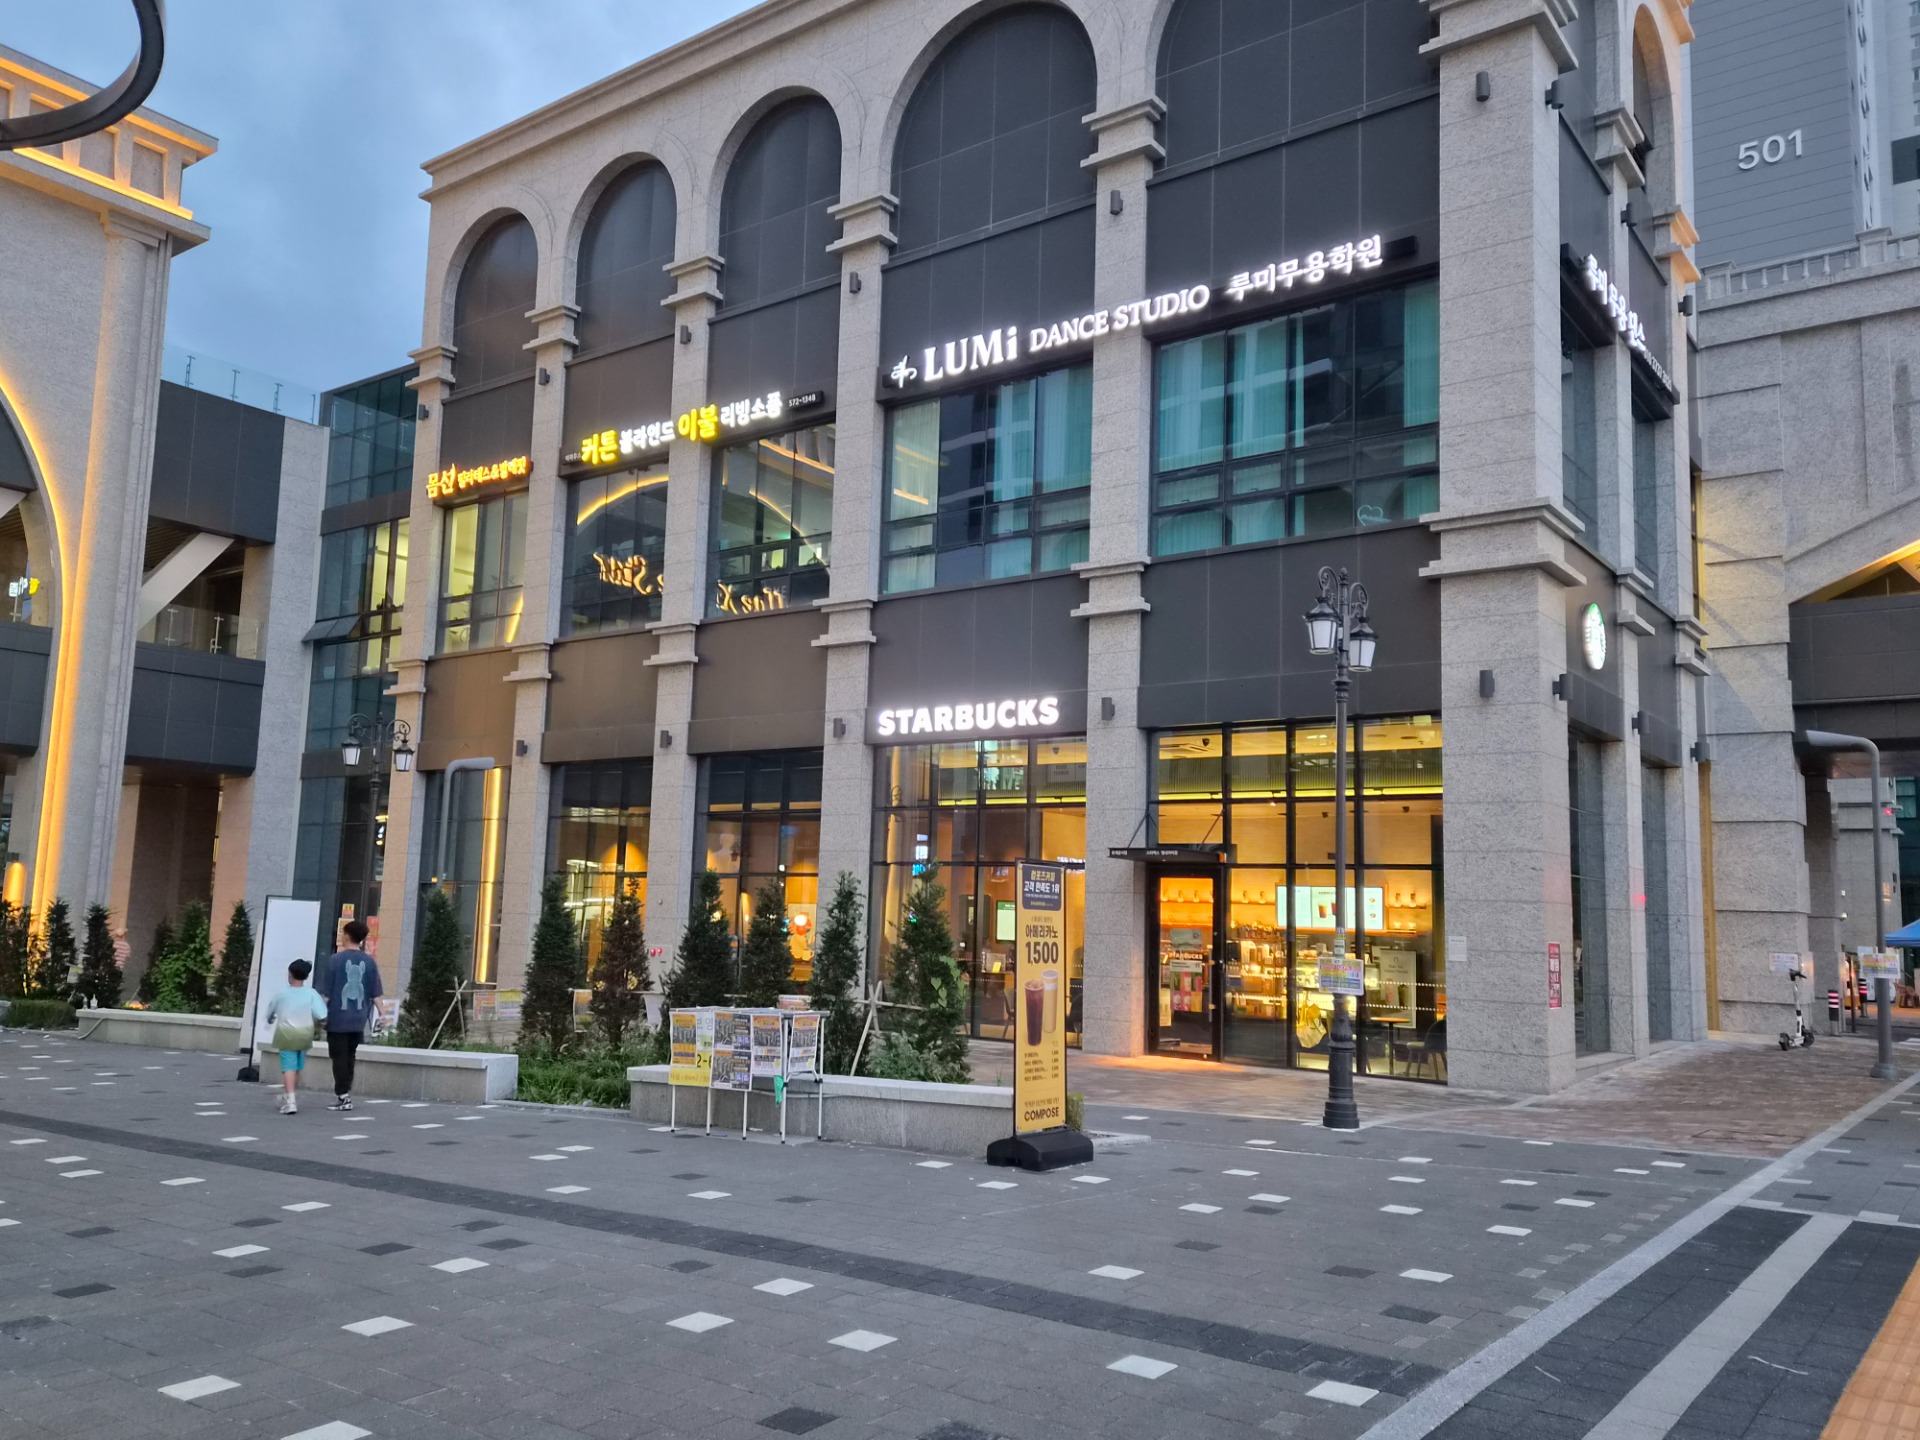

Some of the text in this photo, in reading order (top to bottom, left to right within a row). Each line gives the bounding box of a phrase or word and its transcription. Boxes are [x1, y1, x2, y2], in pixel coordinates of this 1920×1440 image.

[1738, 128, 1803, 170] 501
[1227, 233, 1384, 300] 루미무용학원
[1029, 311, 1109, 353] DANCE
[1112, 284, 1211, 331] STUDIO
[580, 429, 619, 465] 커튼
[618, 420, 676, 454] 블라인드
[678, 404, 719, 441] 이불
[720, 391, 783, 427] 리빙소품
[426, 463, 456, 498] 몸선
[878, 697, 1060, 736] STARBUCKS
[1025, 924, 1059, 939] 아메리카노
[1025, 941, 1060, 966] 1,500
[1024, 1107, 1060, 1122] COMPOSE
